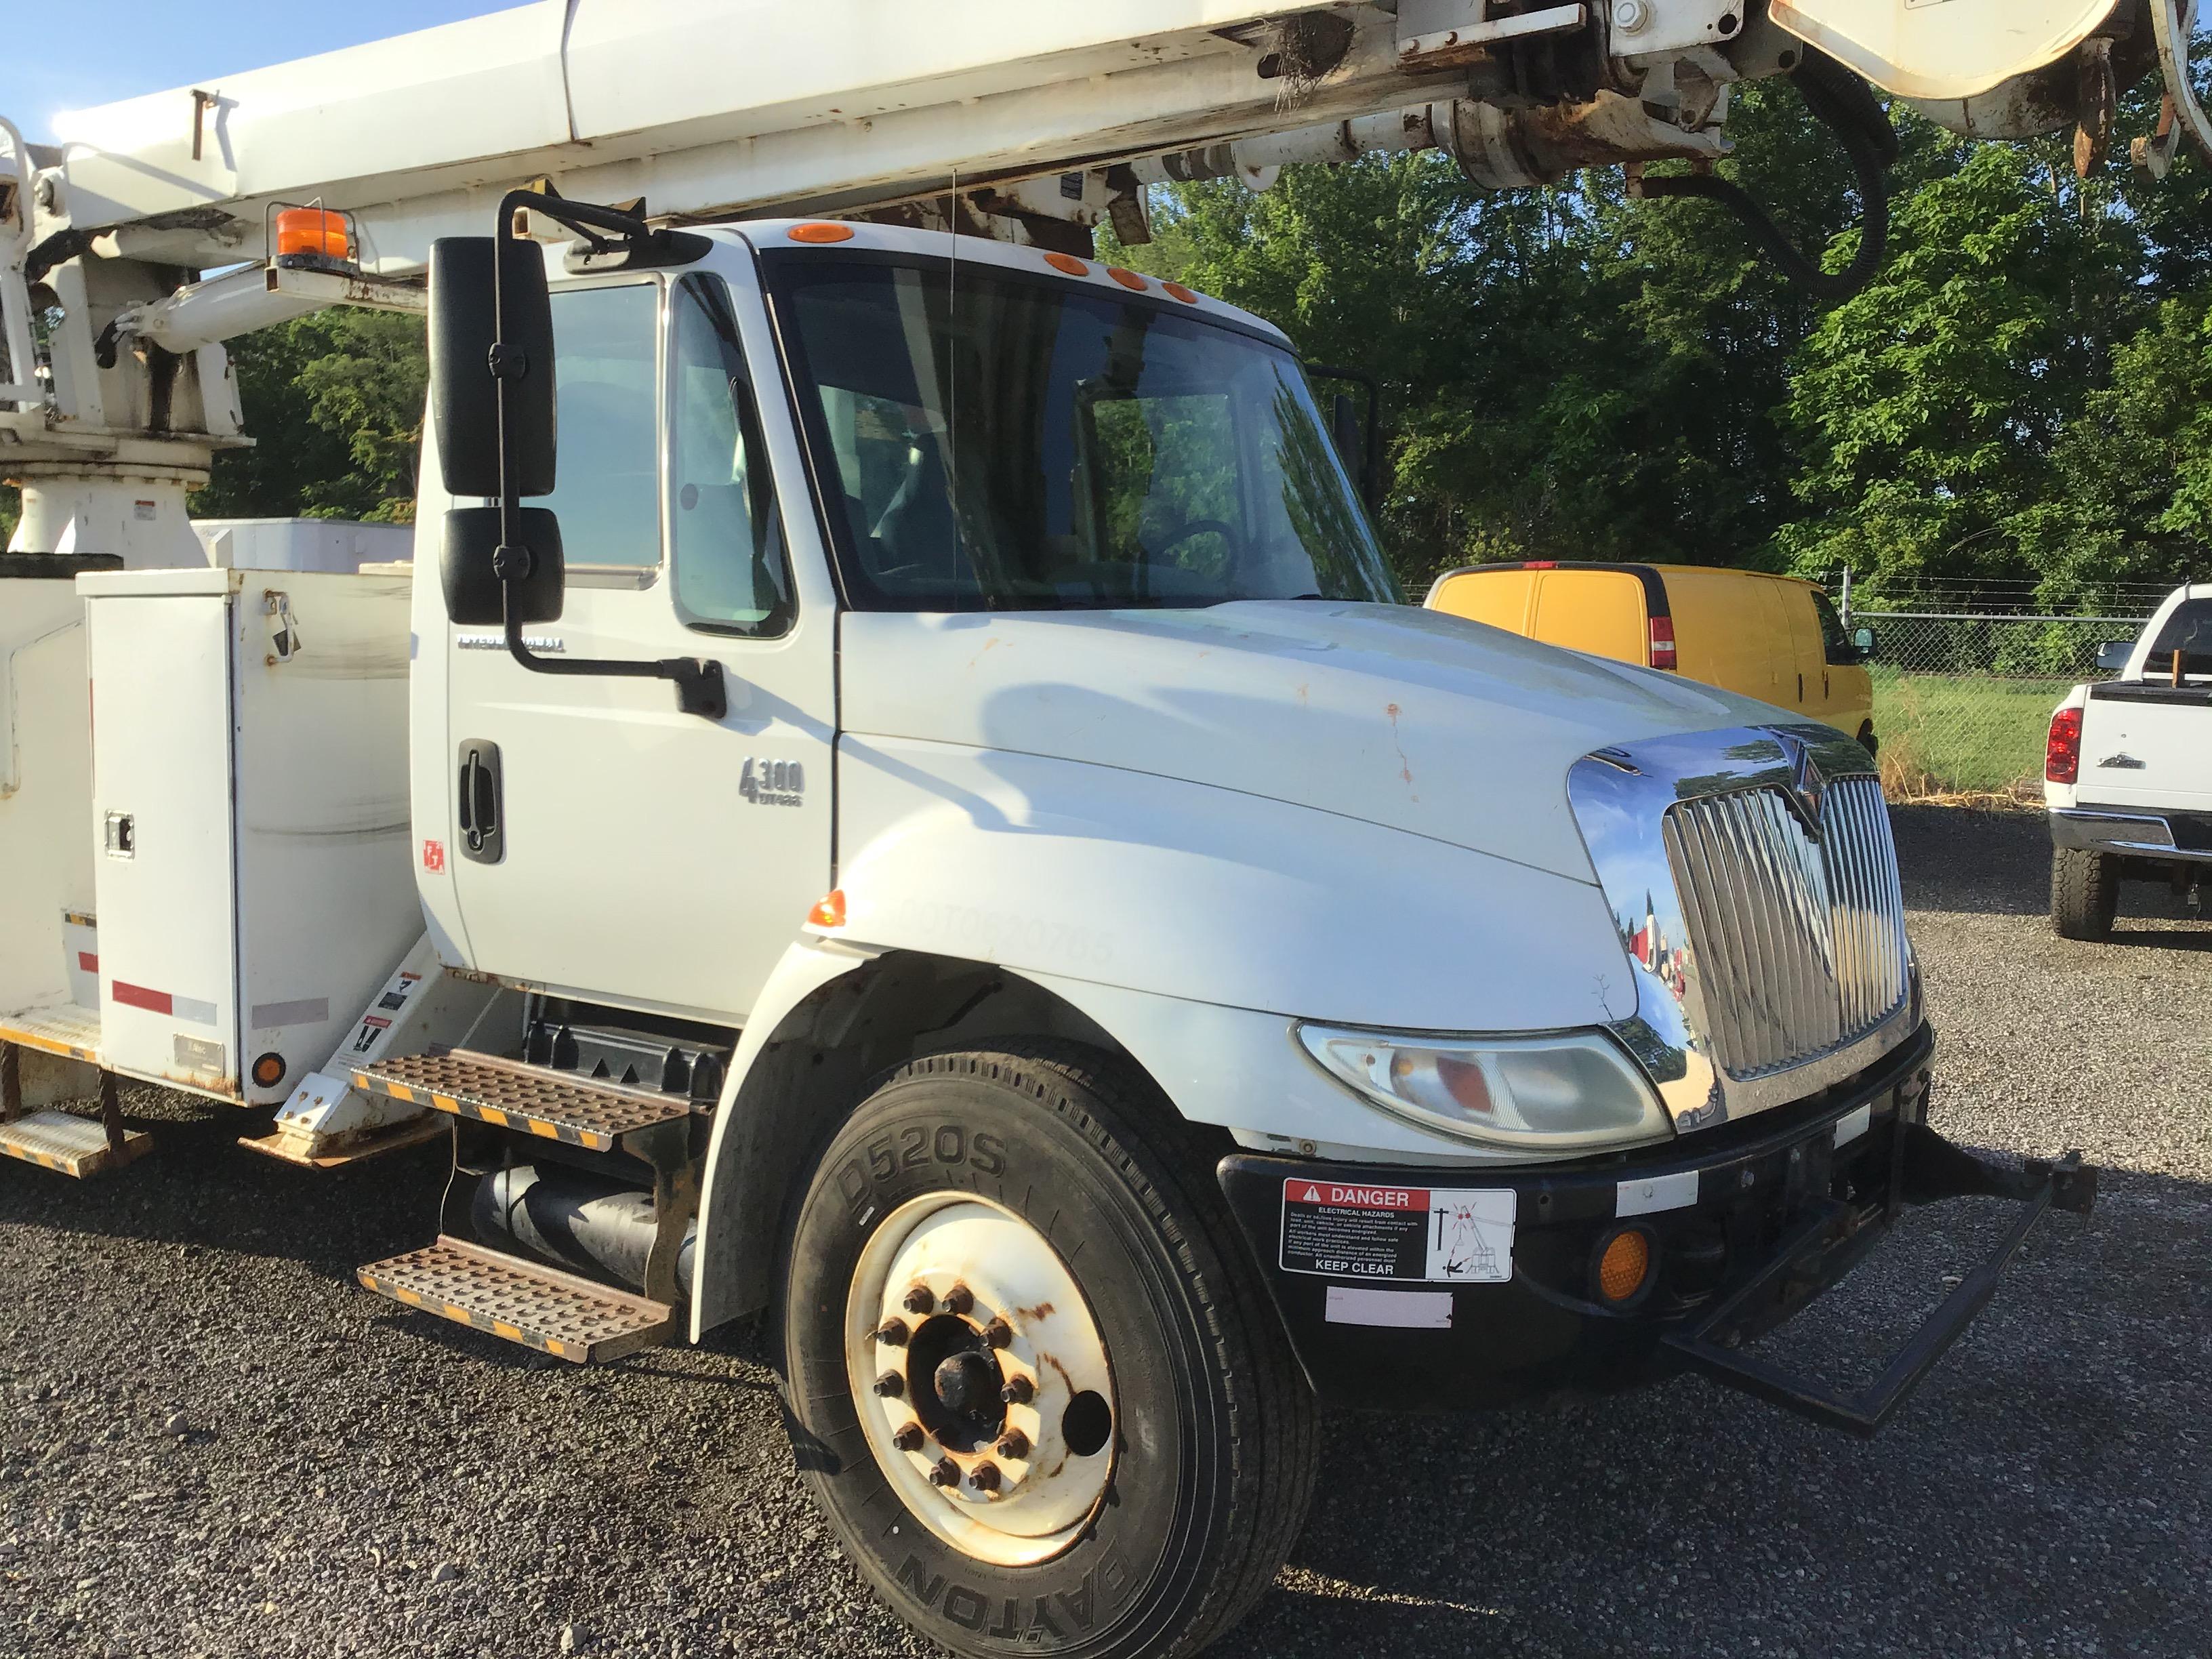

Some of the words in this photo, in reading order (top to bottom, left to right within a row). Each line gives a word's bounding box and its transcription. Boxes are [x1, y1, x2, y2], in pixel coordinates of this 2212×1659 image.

[739, 756, 805, 804] 4300
[836, 1125, 1008, 1214] D520S
[1318, 1207, 1361, 1216] ELECTRICAL
[1332, 1187, 1410, 1206] DANGER
[1315, 1259, 1349, 1271] KEEP
[1351, 1263, 1394, 1275] CLEAR
[894, 1536, 1139, 1641] DAYTON
